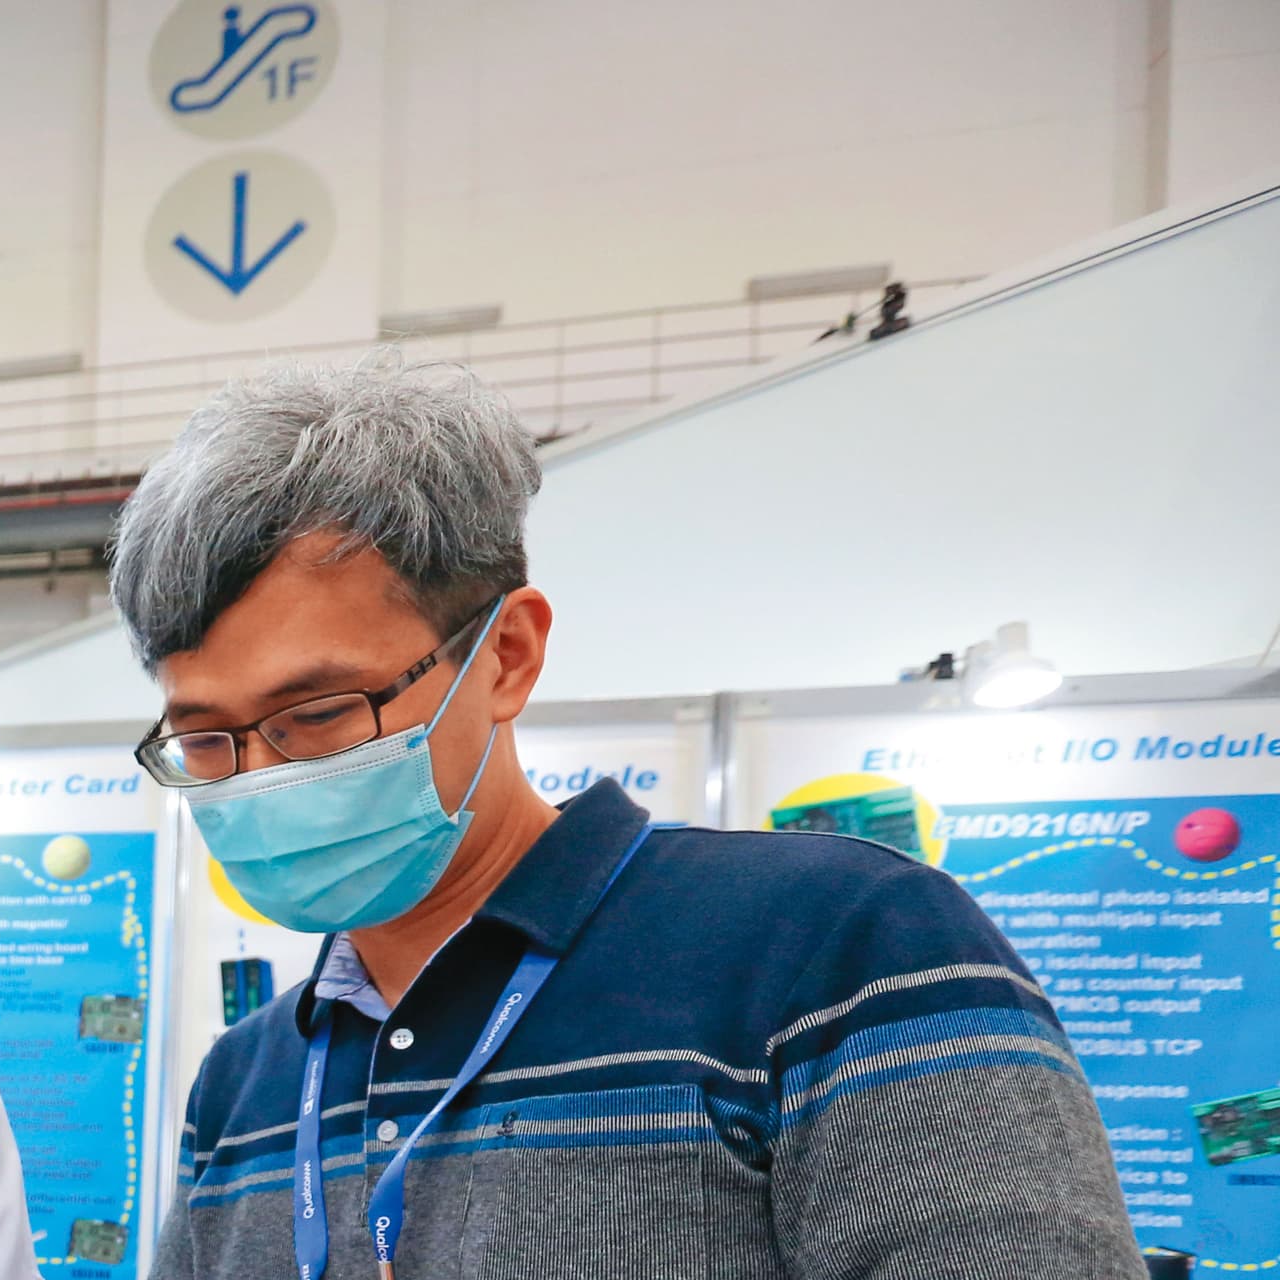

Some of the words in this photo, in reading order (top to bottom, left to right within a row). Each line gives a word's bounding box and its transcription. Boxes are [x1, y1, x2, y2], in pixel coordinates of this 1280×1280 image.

[261, 56, 319, 103] 1F
[64, 774, 140, 795] Card
[934, 811, 1151, 839] EMD9216N/P
[480, 992, 523, 1056] Qualcomm
[1152, 1039, 1203, 1055] TCP
[302, 1159, 316, 1220] Qualcomm
